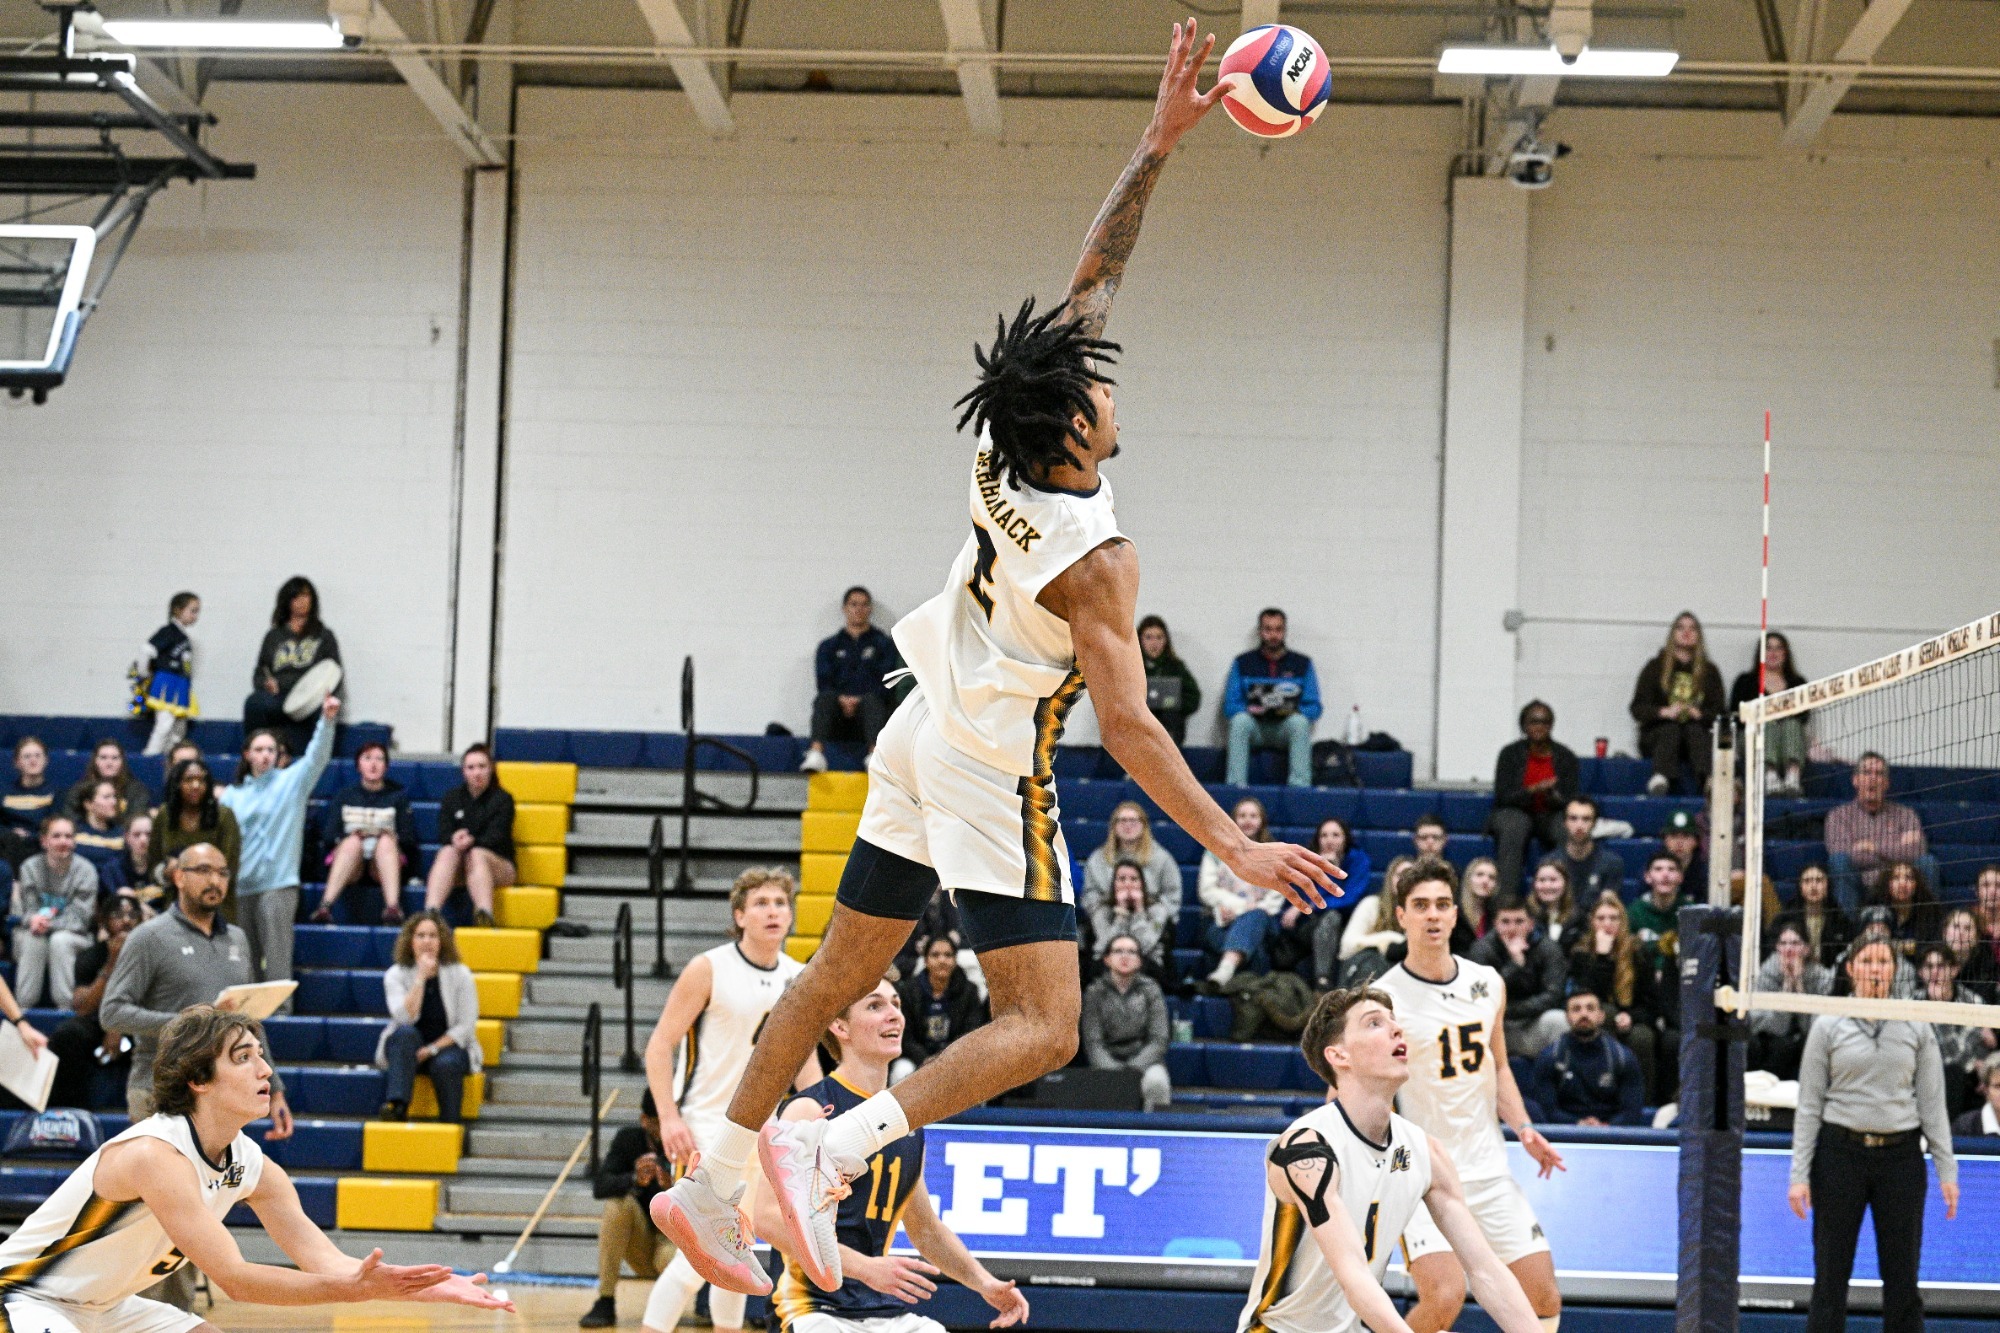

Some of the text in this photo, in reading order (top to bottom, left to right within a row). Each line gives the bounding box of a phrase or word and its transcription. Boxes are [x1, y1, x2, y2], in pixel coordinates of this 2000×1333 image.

[1286, 46, 1313, 83] NCAA
[1437, 1020, 1485, 1079] 15
[865, 1153, 902, 1223] 11
